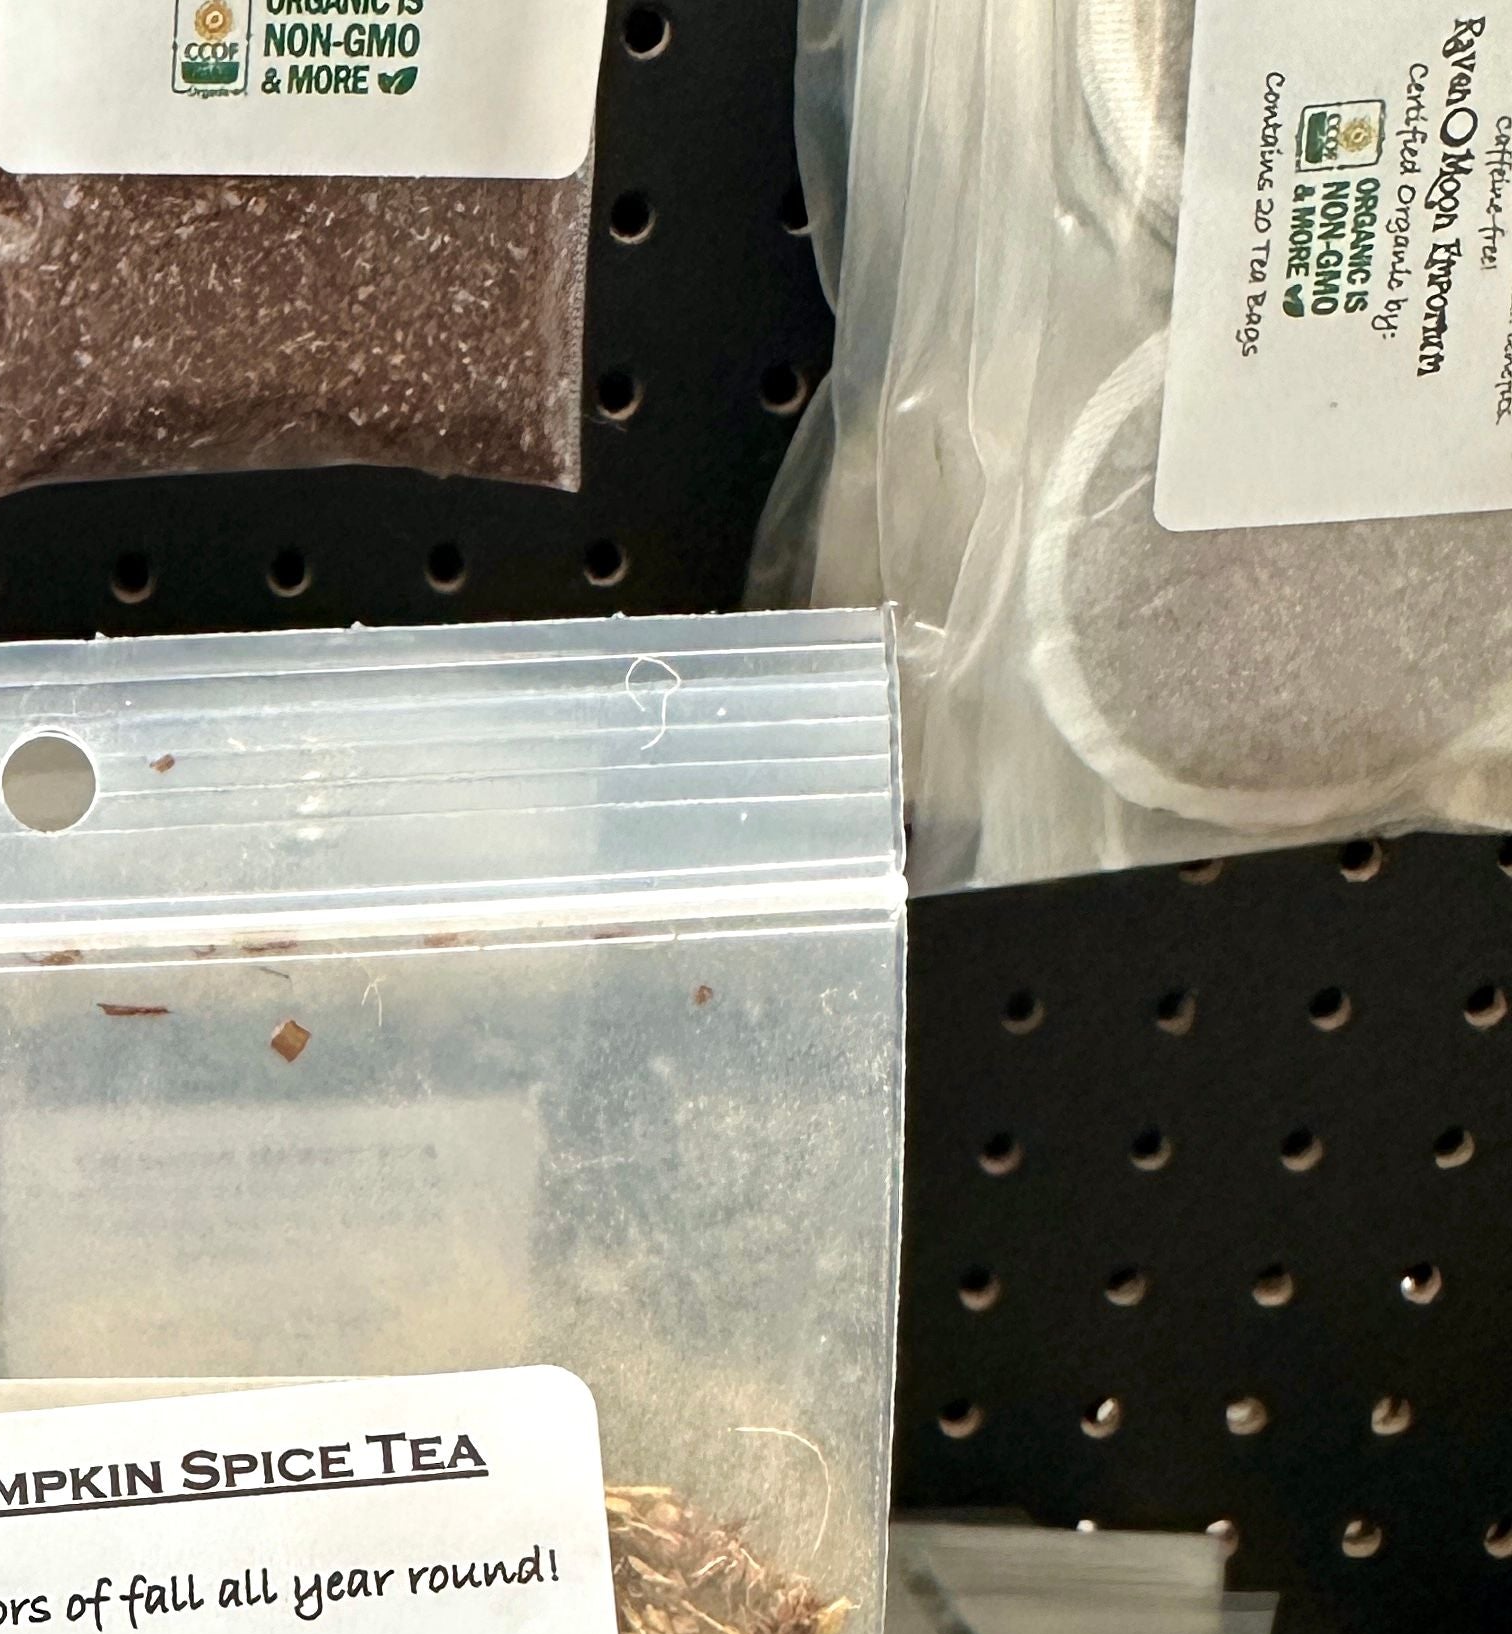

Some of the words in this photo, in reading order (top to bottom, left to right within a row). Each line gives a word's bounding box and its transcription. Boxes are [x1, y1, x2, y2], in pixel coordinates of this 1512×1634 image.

[263, 22, 421, 58] NON-GMO
[260, 67, 281, 95] &
[288, 65, 370, 95] MORE
[1257, 72, 1285, 191] Contains
[1254, 198, 1275, 233] 20
[1292, 184, 1317, 203] &
[1286, 206, 1317, 280] MORE
[1311, 180, 1351, 316] NON-GMO
[1347, 177, 1381, 286] ORGANIC
[1249, 239, 1271, 284] Tea
[1236, 290, 1267, 357] Bags
[1343, 290, 1369, 314] IS
[181, 1442, 354, 1491] SPICE
[365, 1433, 486, 1474] TEA
[66, 1576, 112, 1631] of
[119, 1573, 205, 1629] fall
[219, 1568, 278, 1608] all
[293, 1567, 395, 1621] year
[408, 1545, 561, 1595] round!
